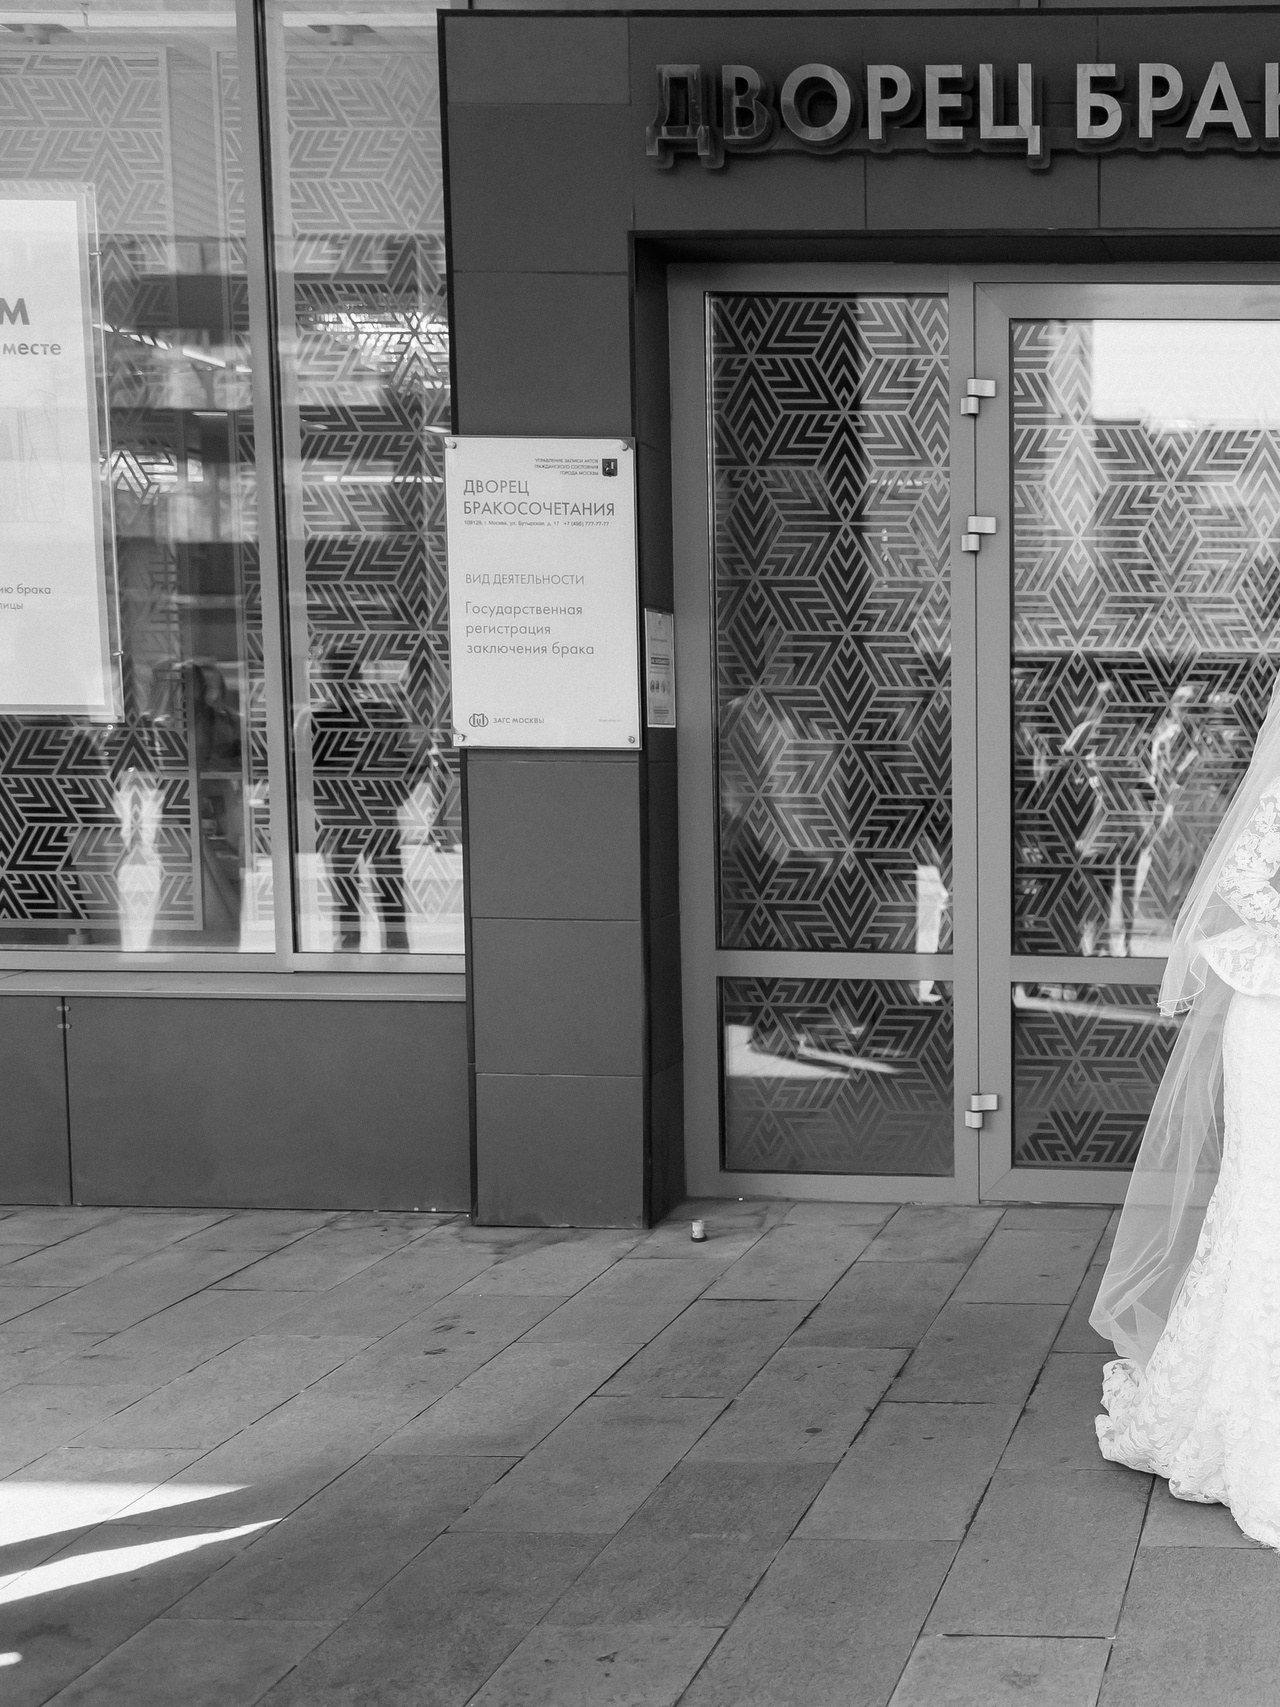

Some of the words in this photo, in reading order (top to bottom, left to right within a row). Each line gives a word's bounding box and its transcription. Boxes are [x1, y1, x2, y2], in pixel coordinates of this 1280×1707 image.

[646, 62, 1042, 158] ДВОРЕЦ
[2, 343, 62, 355] месте
[463, 479, 530, 496] ДВОРЕЦ
[463, 501, 615, 516] БРАКОСОЧЕТАНИЯ
[465, 573, 490, 586] ВИД
[493, 574, 585, 586] ДЕЯТЕЛЬНОСТИ
[16, 583, 51, 597] брака
[465, 601, 583, 618] Государственная
[465, 625, 551, 638] регистрация
[466, 644, 548, 655] заключения
[552, 641, 595, 658] брака
